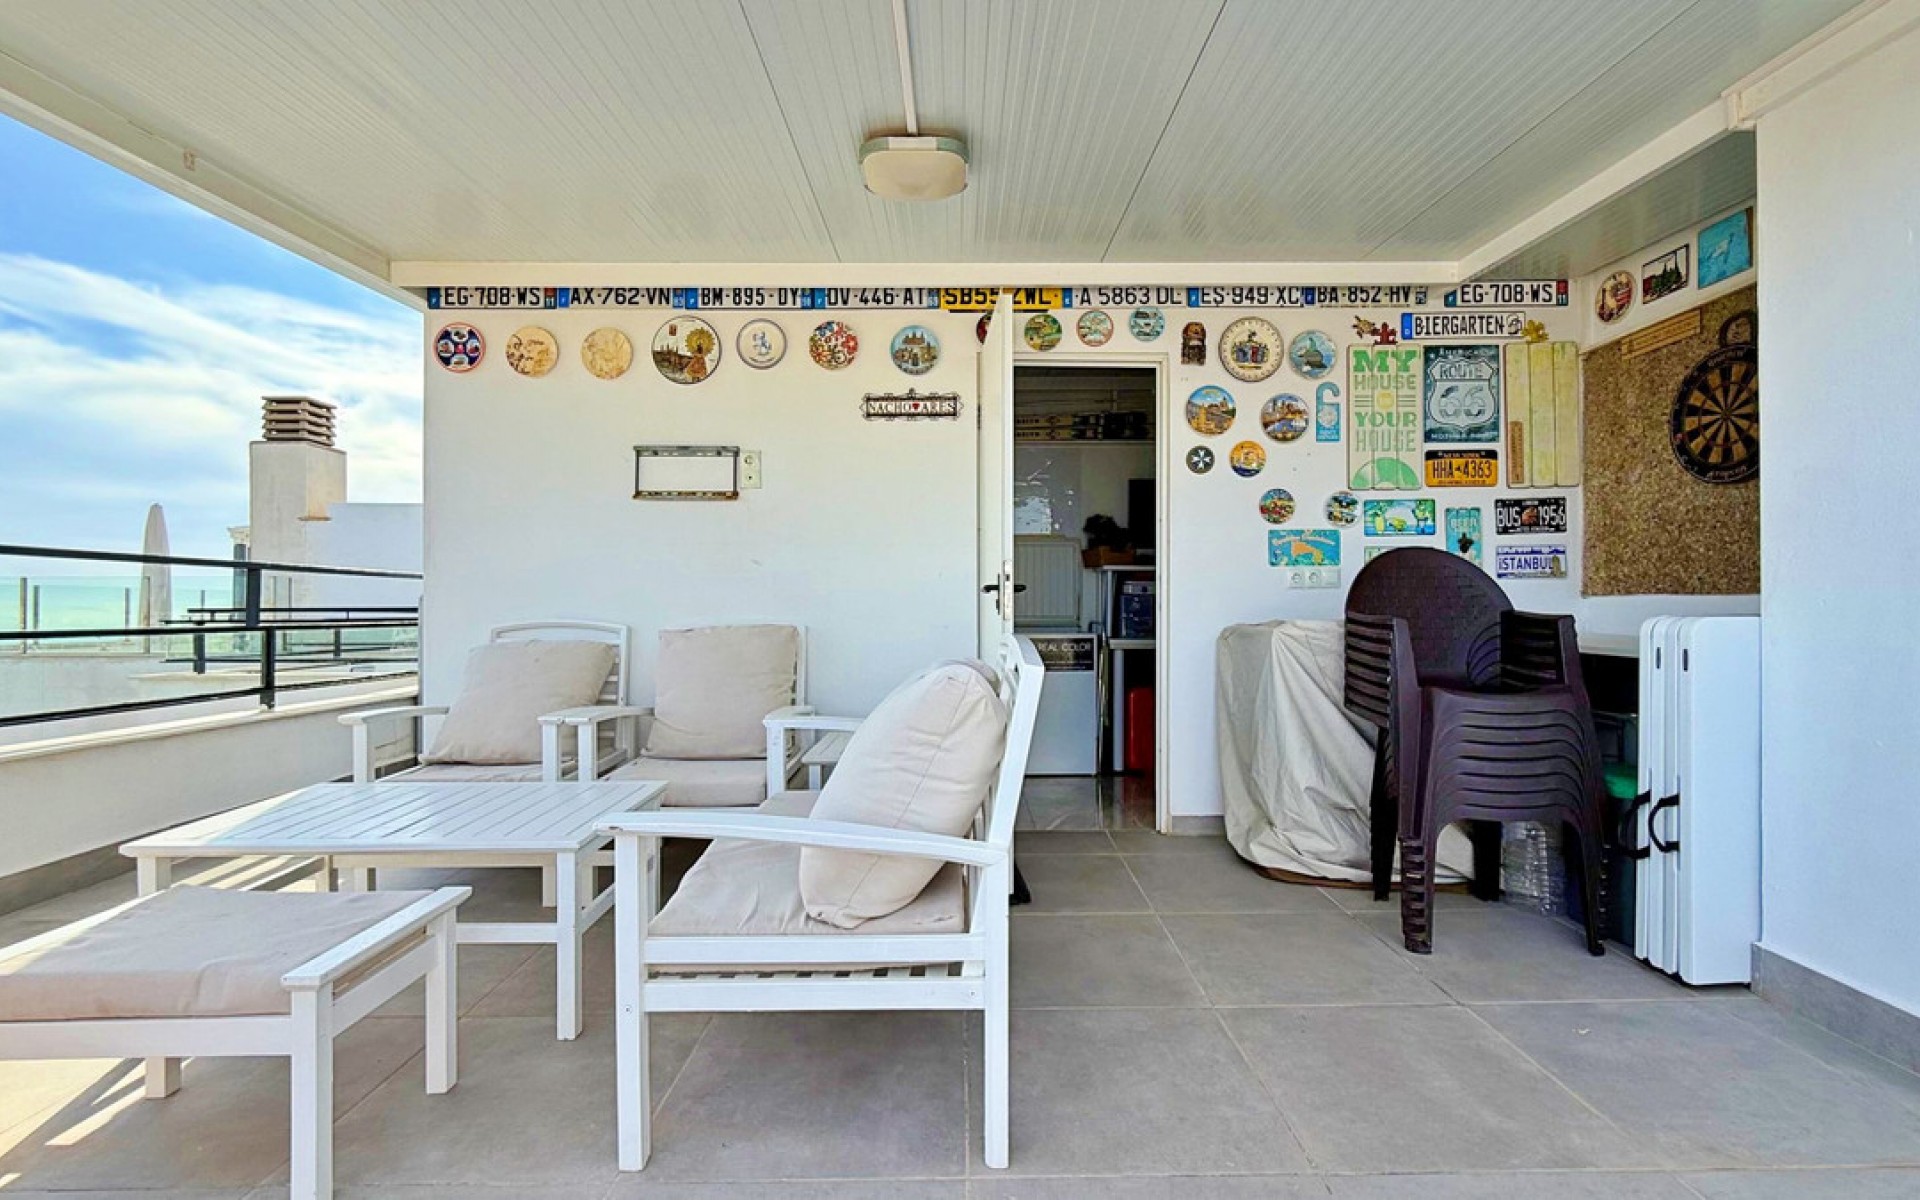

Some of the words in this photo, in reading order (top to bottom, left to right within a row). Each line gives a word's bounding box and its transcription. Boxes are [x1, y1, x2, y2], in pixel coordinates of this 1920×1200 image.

[444, 287, 540, 305] EG-708-WS
[571, 288, 670, 304] AX-762-VN
[1080, 287, 1091, 304] A
[1099, 287, 1150, 304] 5863
[1461, 284, 1553, 303] EG-708-WS
[1414, 315, 1505, 335] BIERGARTEN
[1353, 349, 1419, 372] MY
[1439, 363, 1484, 379] ROUTE
[1354, 374, 1417, 390] HOUSE
[868, 400, 912, 414] NACHO
[921, 400, 956, 414] ARES
[1438, 385, 1486, 418] 66
[1354, 411, 1418, 427] YOUR
[1356, 429, 1417, 451] HOUSE
[1496, 506, 1522, 527] BUS
[1538, 505, 1566, 526] 1956
